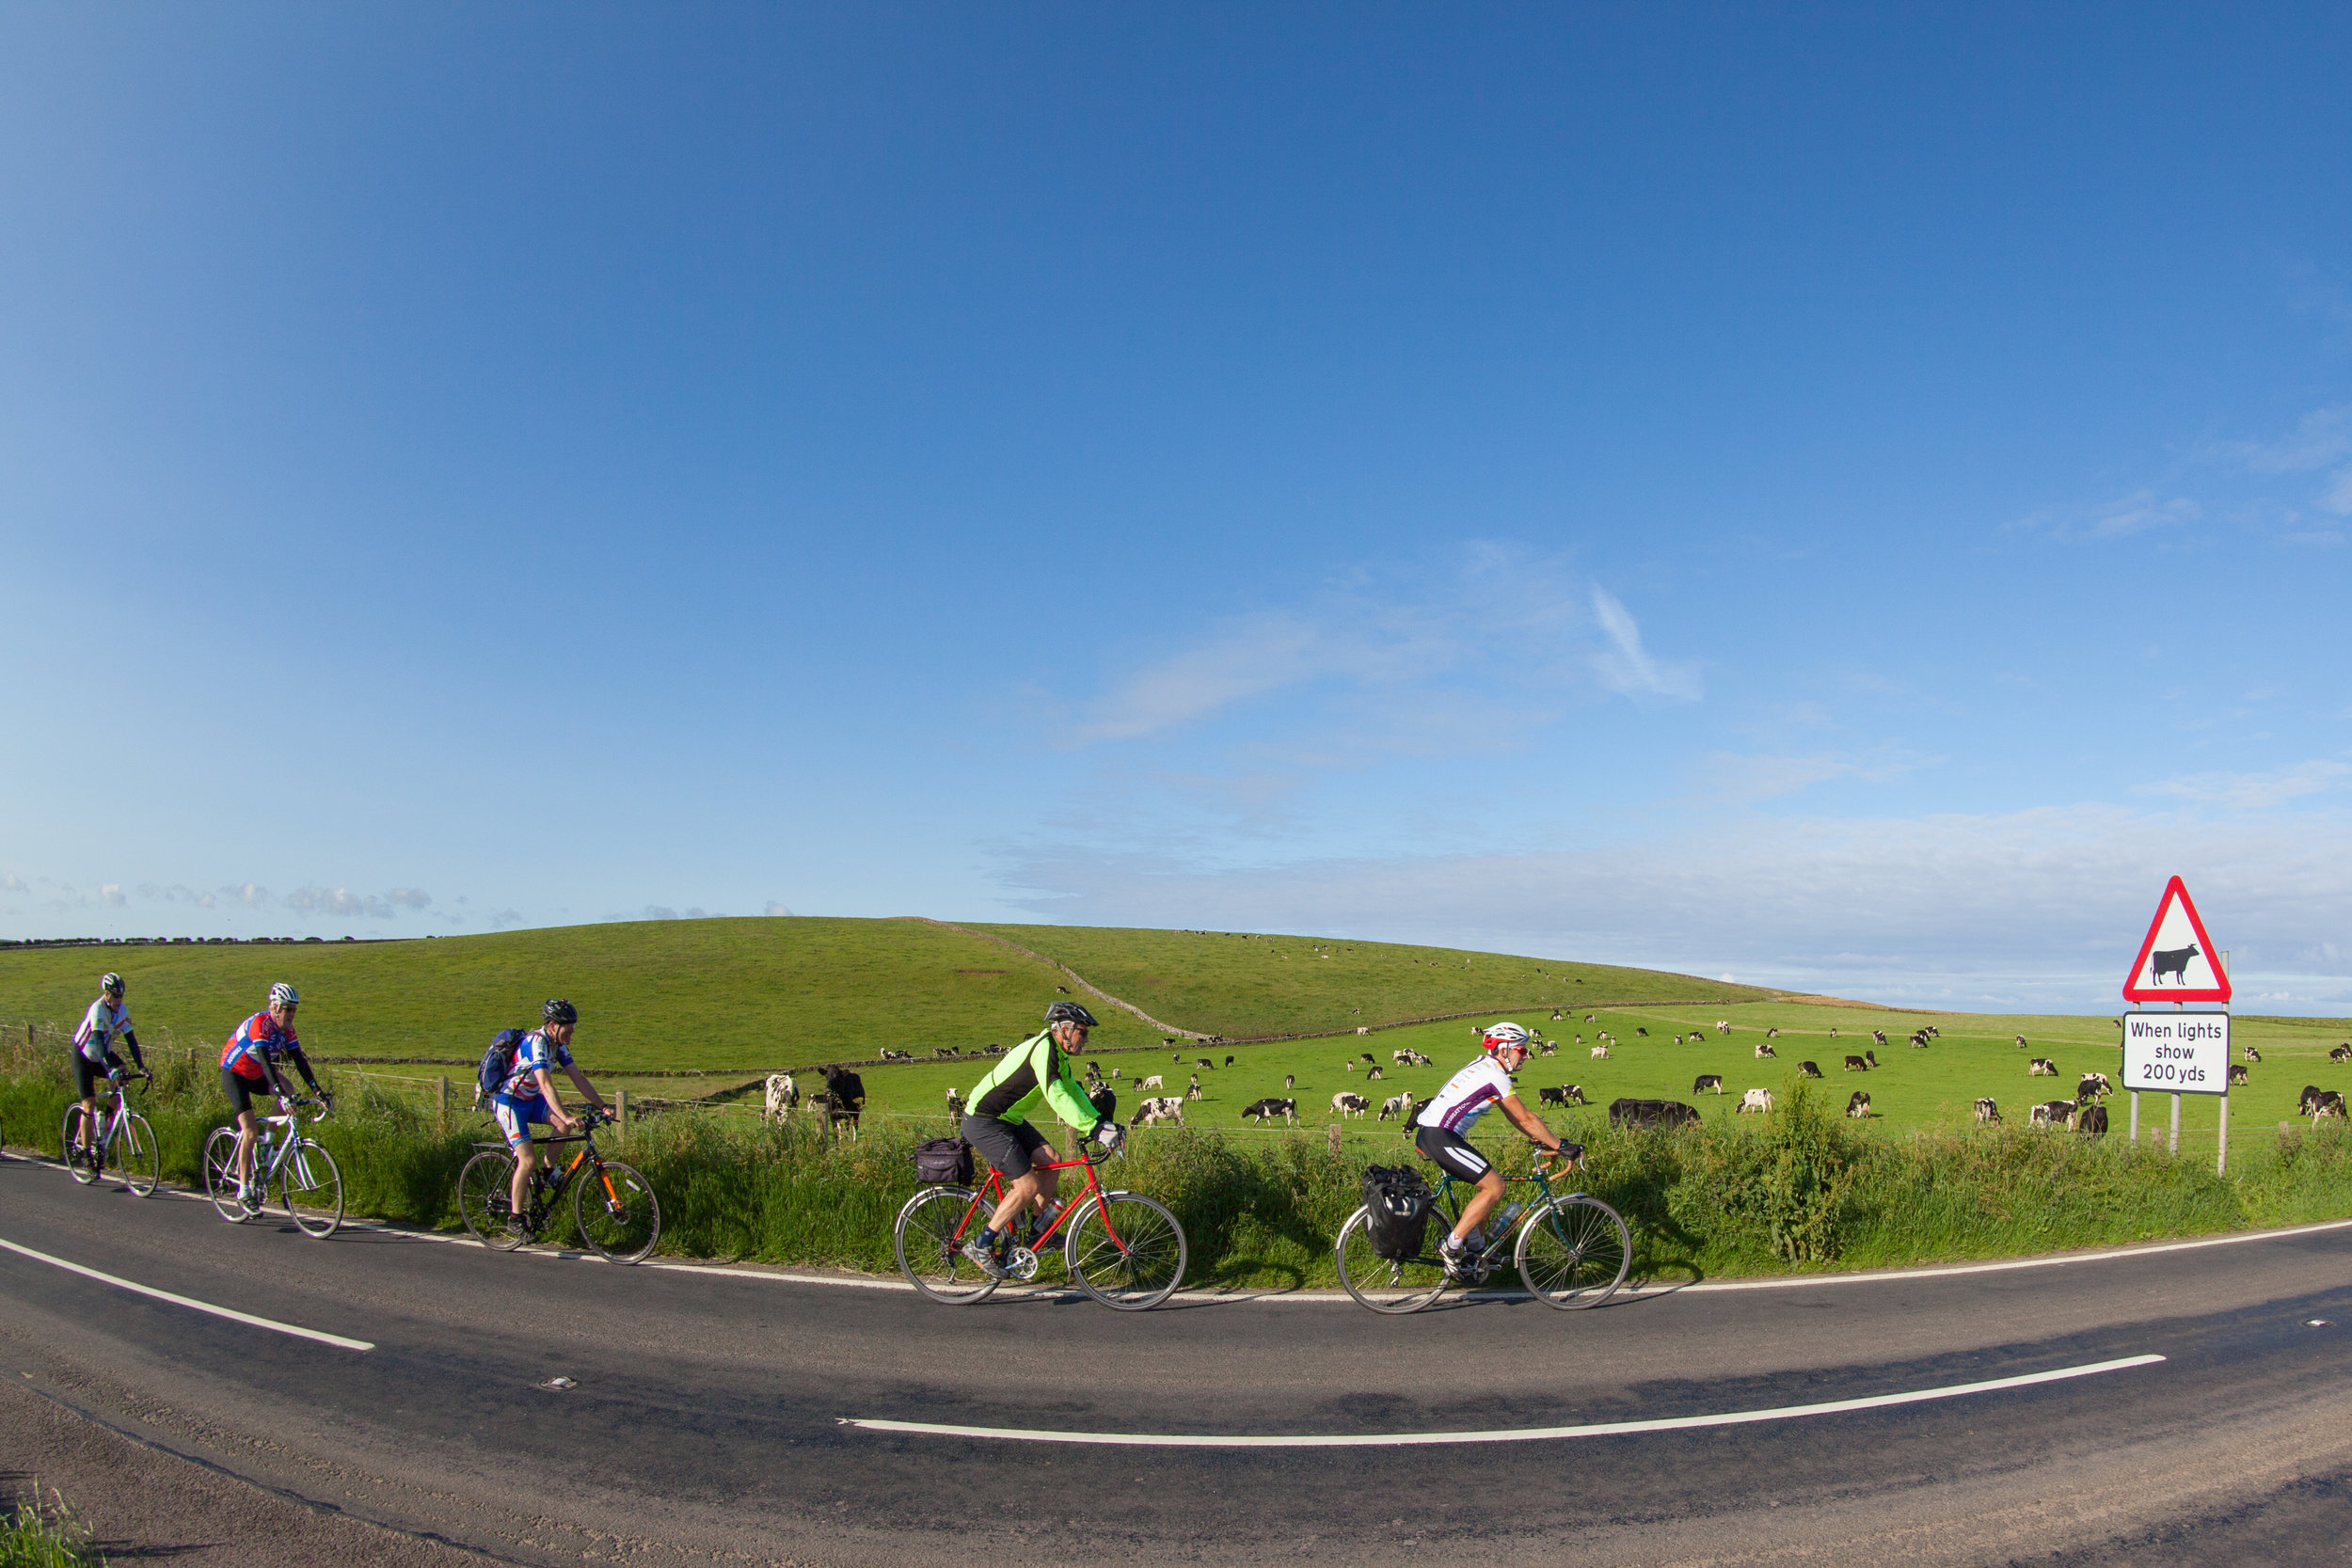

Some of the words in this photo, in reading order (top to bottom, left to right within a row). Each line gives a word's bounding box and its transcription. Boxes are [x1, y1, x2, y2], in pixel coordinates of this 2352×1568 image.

[2131, 1022, 2172, 1038] When
[2178, 1022, 2221, 1041] lights
[2155, 1043, 2195, 1059] show
[2143, 1063, 2175, 1081] 200
[2179, 1065, 2205, 1085] yds
